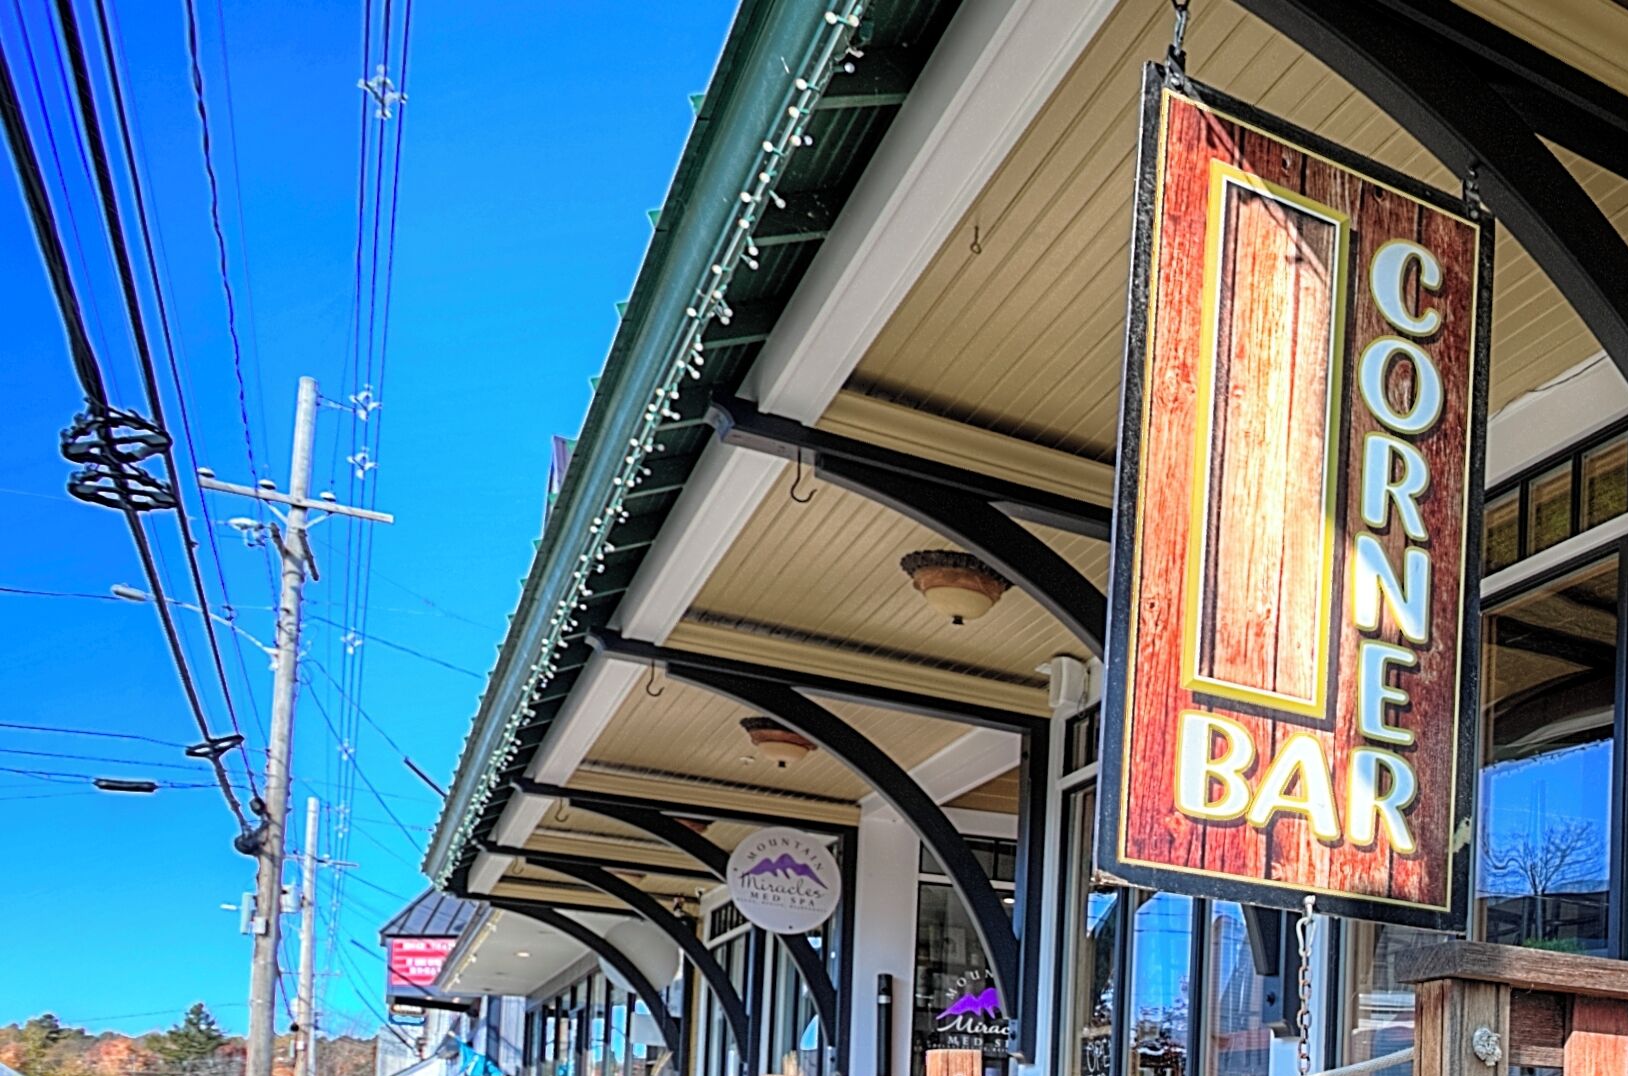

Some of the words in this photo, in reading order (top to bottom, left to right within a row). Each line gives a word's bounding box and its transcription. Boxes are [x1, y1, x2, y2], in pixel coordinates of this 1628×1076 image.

[1351, 238, 1444, 854] CORNER
[1174, 709, 1418, 854] BAR
[747, 837, 824, 872] MOUNTAIN
[740, 875, 824, 898] Miracles
[750, 891, 781, 902] MED
[790, 896, 815, 907] SPA
[945, 968, 995, 1000] MOUN
[937, 1014, 1010, 1035] Mirac
[947, 1035, 984, 1046] MED
